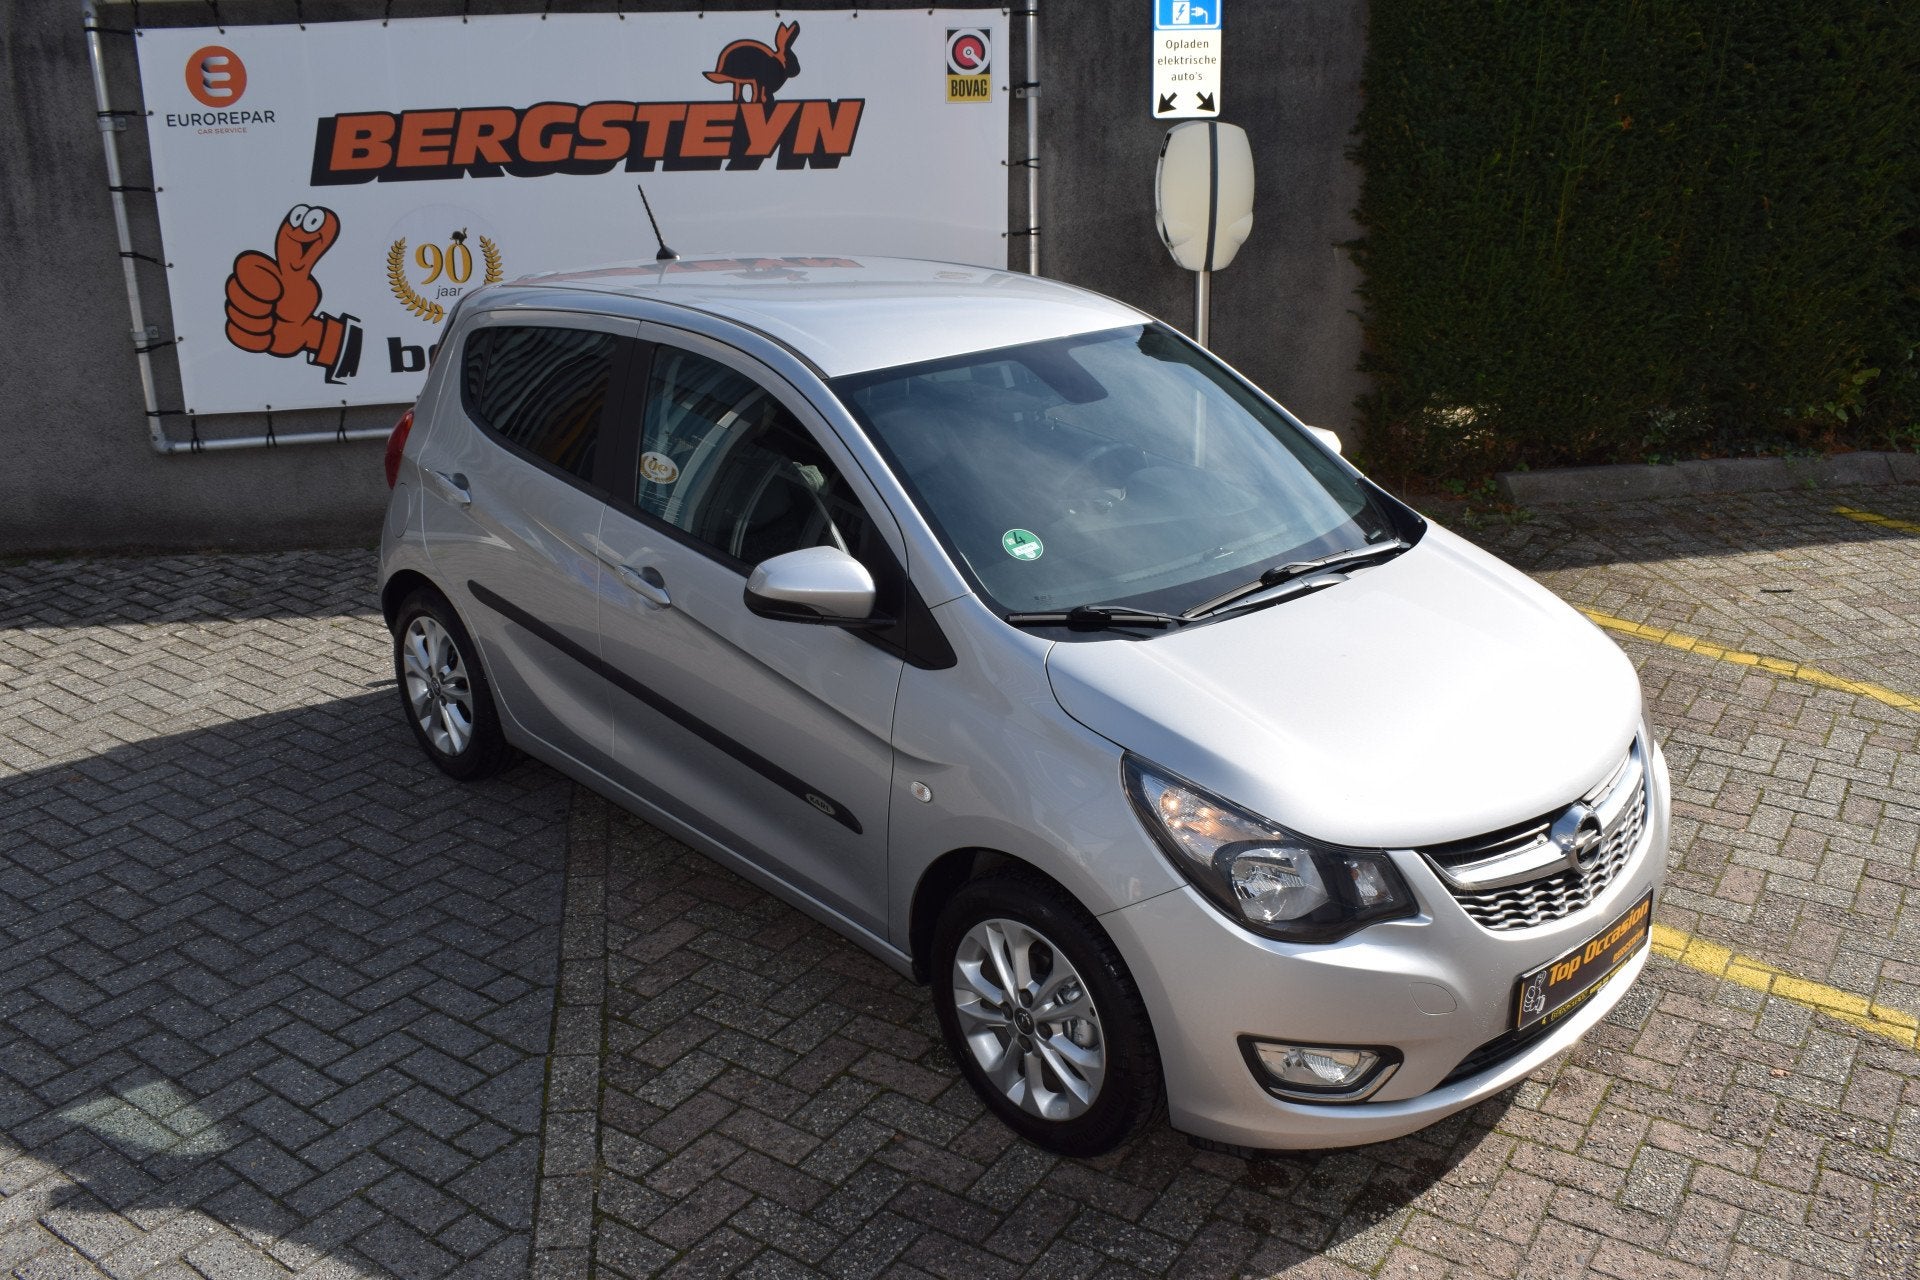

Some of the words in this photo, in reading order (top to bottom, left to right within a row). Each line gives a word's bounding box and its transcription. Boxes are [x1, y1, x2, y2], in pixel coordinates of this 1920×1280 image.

[1165, 39, 1209, 51] Opladen
[1157, 55, 1217, 65] elektrische
[1171, 71, 1203, 81] auto's
[951, 79, 987, 97] BOVAG
[166, 110, 275, 127] EUROREPAR
[311, 98, 865, 186] BERGSTEYN
[415, 243, 473, 285] 90
[436, 285, 463, 299] jaar
[809, 796, 831, 812] KARL
[1549, 955, 1582, 987] Top
[1584, 900, 1650, 965] Occasion
